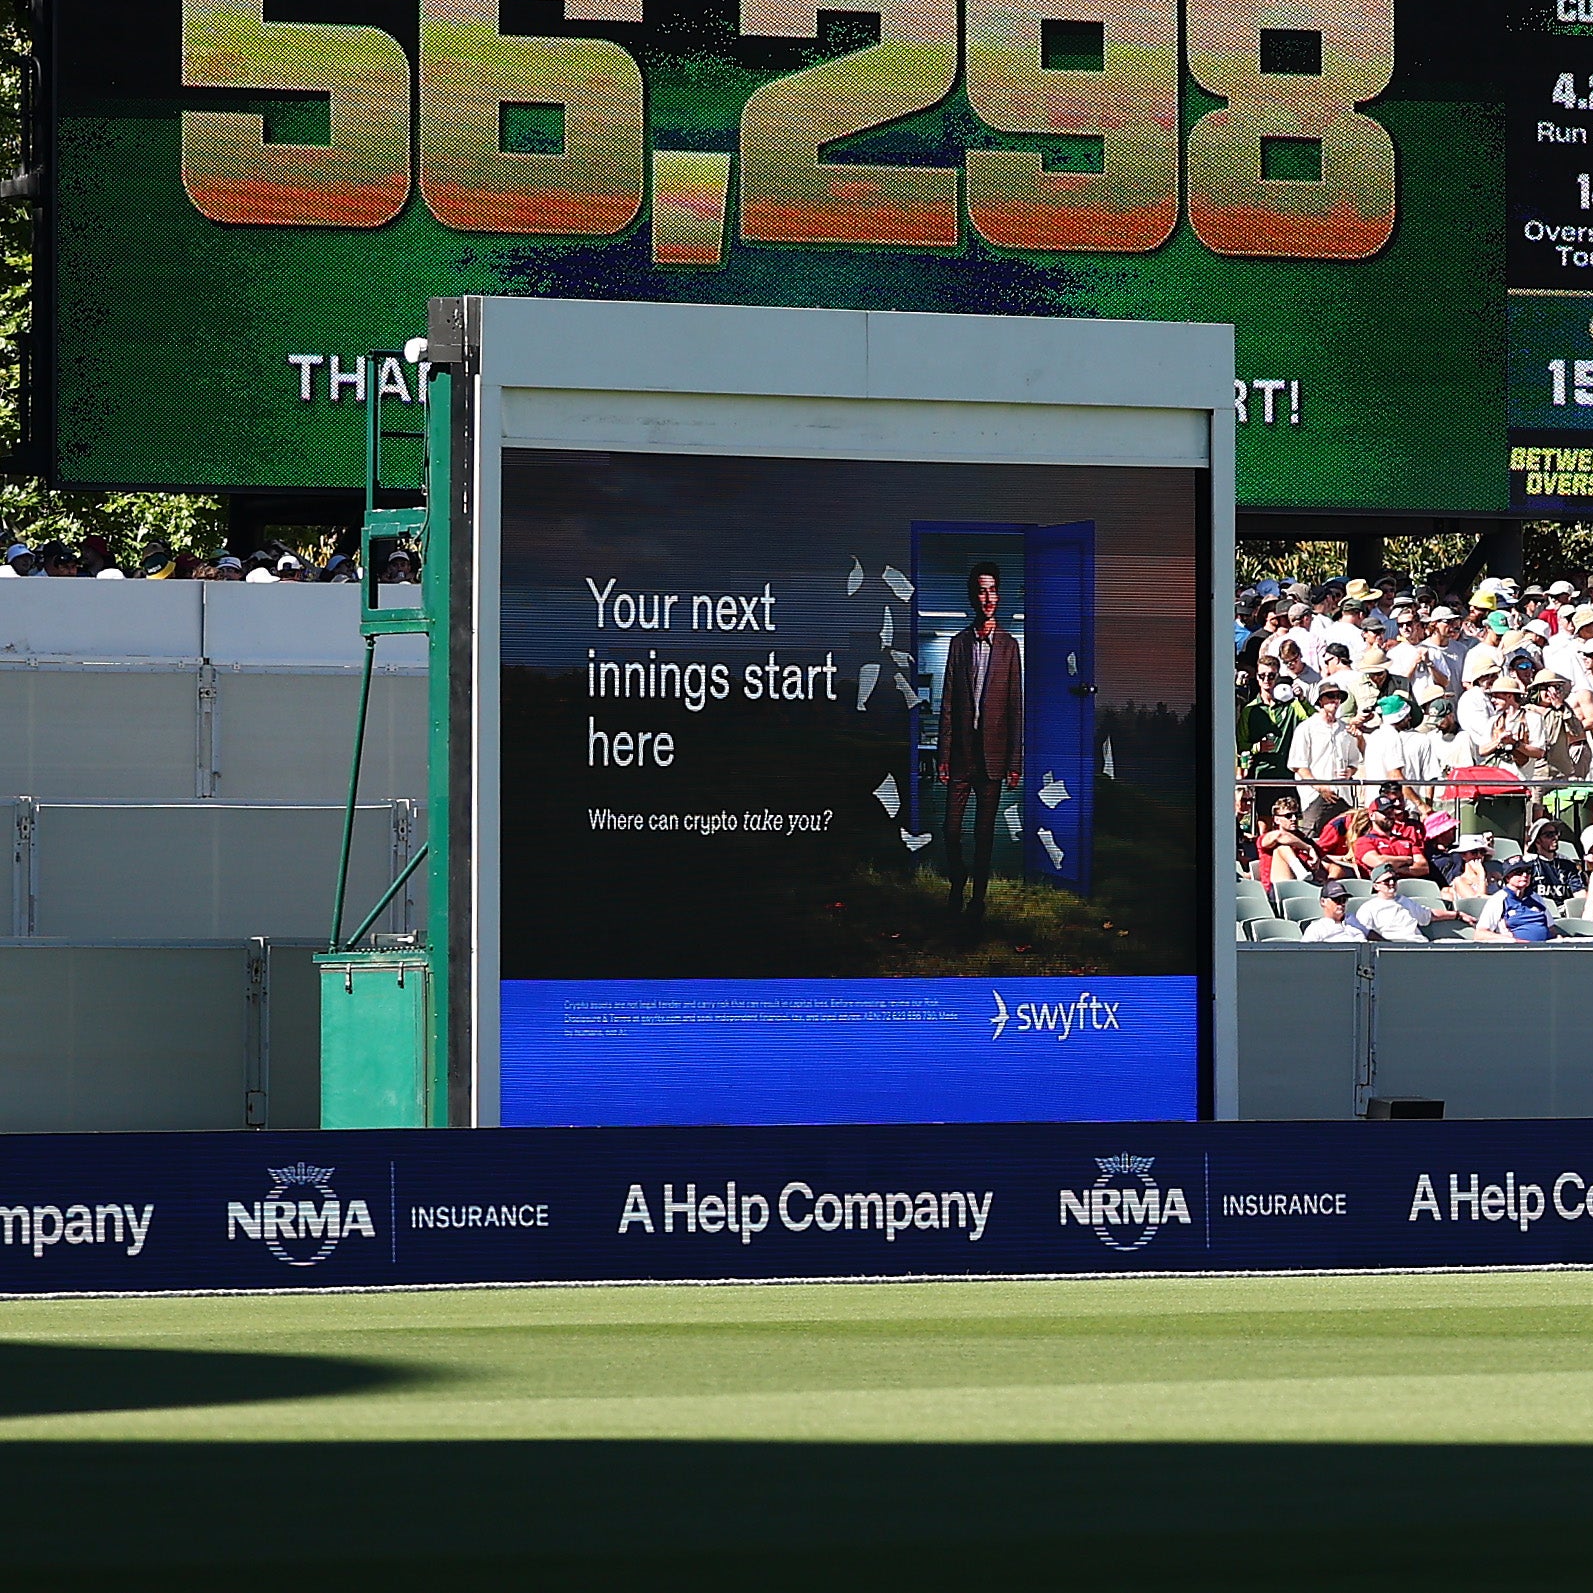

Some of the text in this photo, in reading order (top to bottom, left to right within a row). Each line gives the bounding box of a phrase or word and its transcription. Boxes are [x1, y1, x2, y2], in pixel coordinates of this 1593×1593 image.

[1537, 122, 1587, 146] Run
[585, 577, 777, 633] Your next
[587, 650, 838, 712] innings start
[586, 716, 675, 768] here
[588, 809, 833, 836] Where can crypto take you?
[1016, 992, 1120, 1040] swyftx
[228, 1200, 375, 1241] NRMA
[411, 1205, 549, 1229] INSURANCE
[618, 1181, 994, 1246] A Help Company
